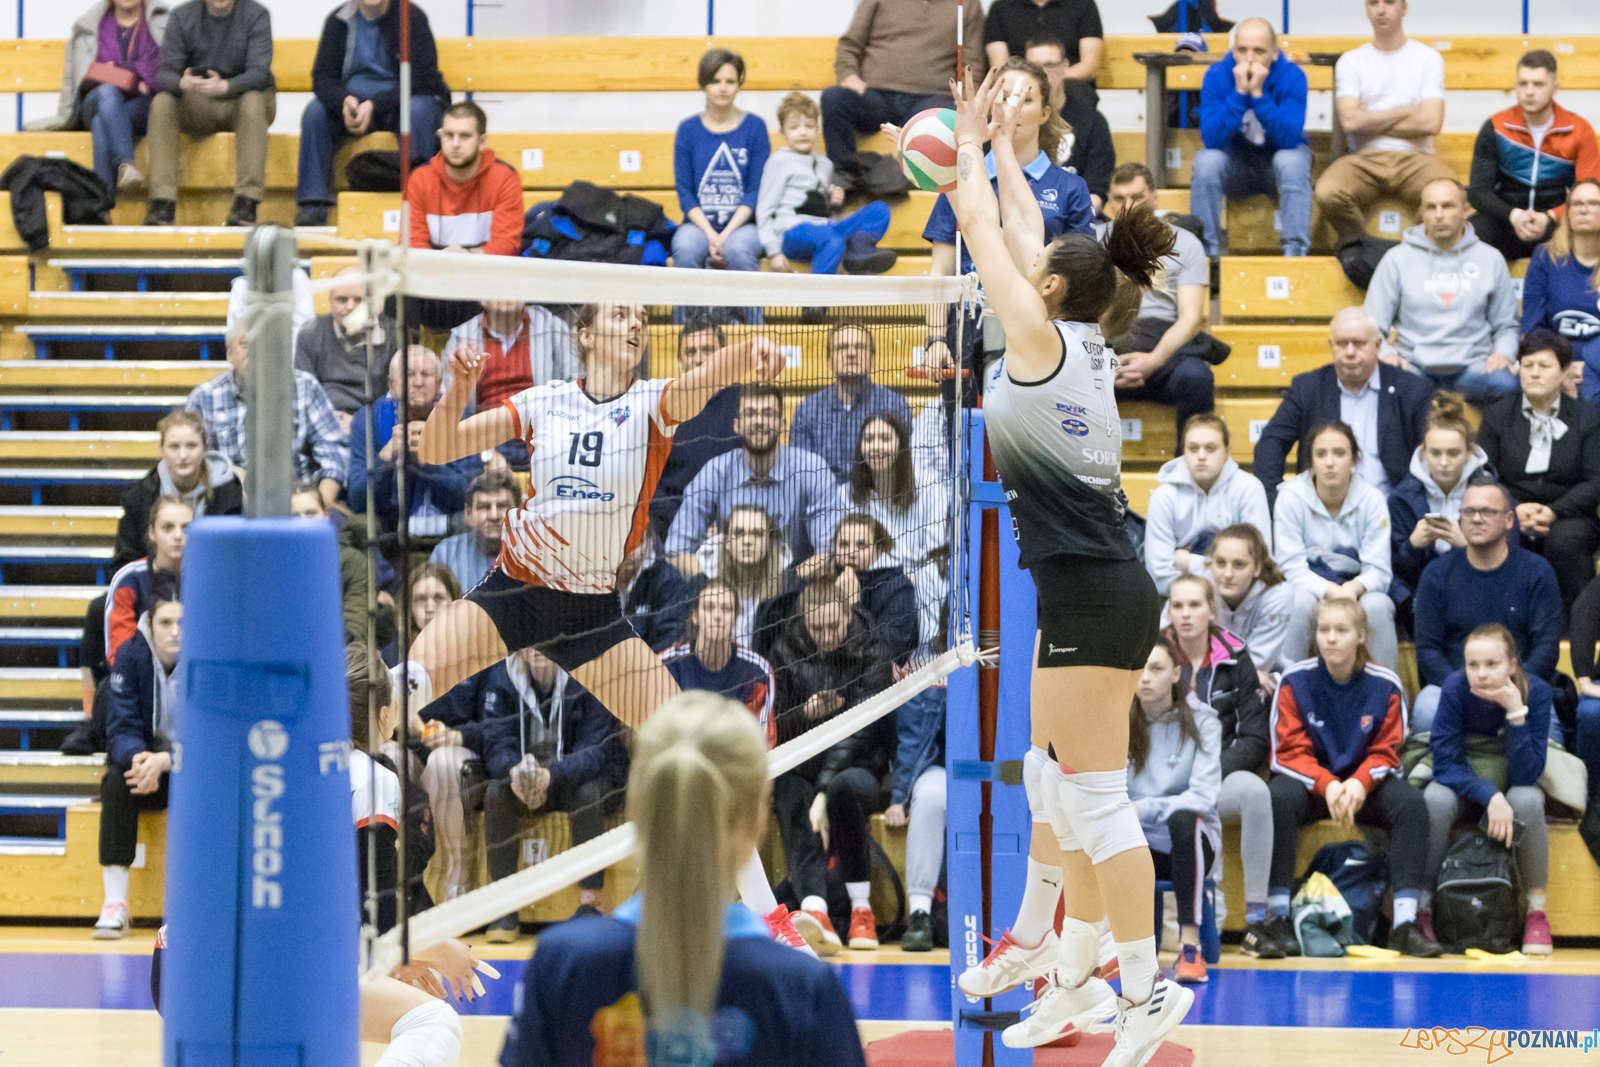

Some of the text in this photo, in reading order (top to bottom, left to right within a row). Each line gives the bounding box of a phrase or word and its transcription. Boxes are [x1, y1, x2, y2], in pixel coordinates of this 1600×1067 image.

[1384, 214, 1395, 224] 15
[1273, 279, 1283, 289] 16
[1263, 349, 1274, 359] 16
[567, 430, 604, 468] 19
[556, 484, 615, 502] Enea
